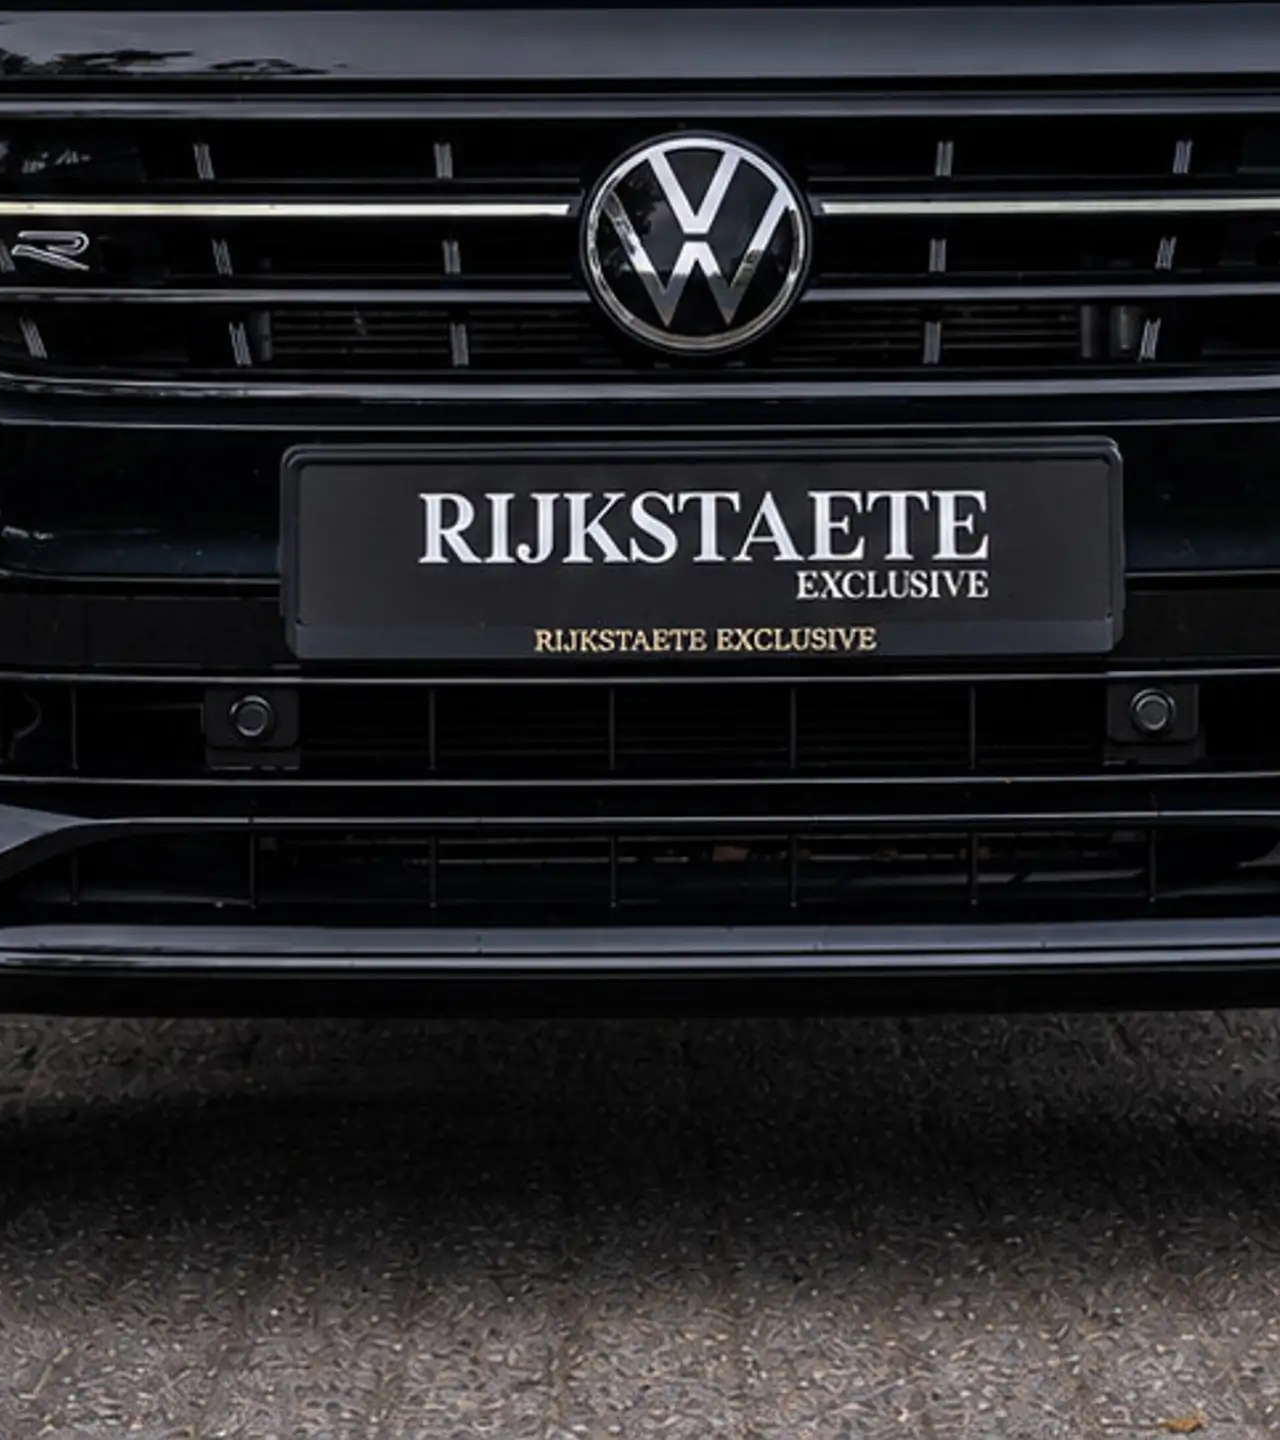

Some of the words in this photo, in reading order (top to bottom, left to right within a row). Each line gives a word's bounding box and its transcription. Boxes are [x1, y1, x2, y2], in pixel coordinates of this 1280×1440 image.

[11, 230, 90, 271] R
[600, 145, 790, 327] VW
[418, 489, 990, 564] RIJKSTAETE
[796, 569, 990, 600] EXCLUSIVE
[534, 627, 708, 654] RIJKSTAETE
[716, 626, 878, 652] EXCLUSIVE
